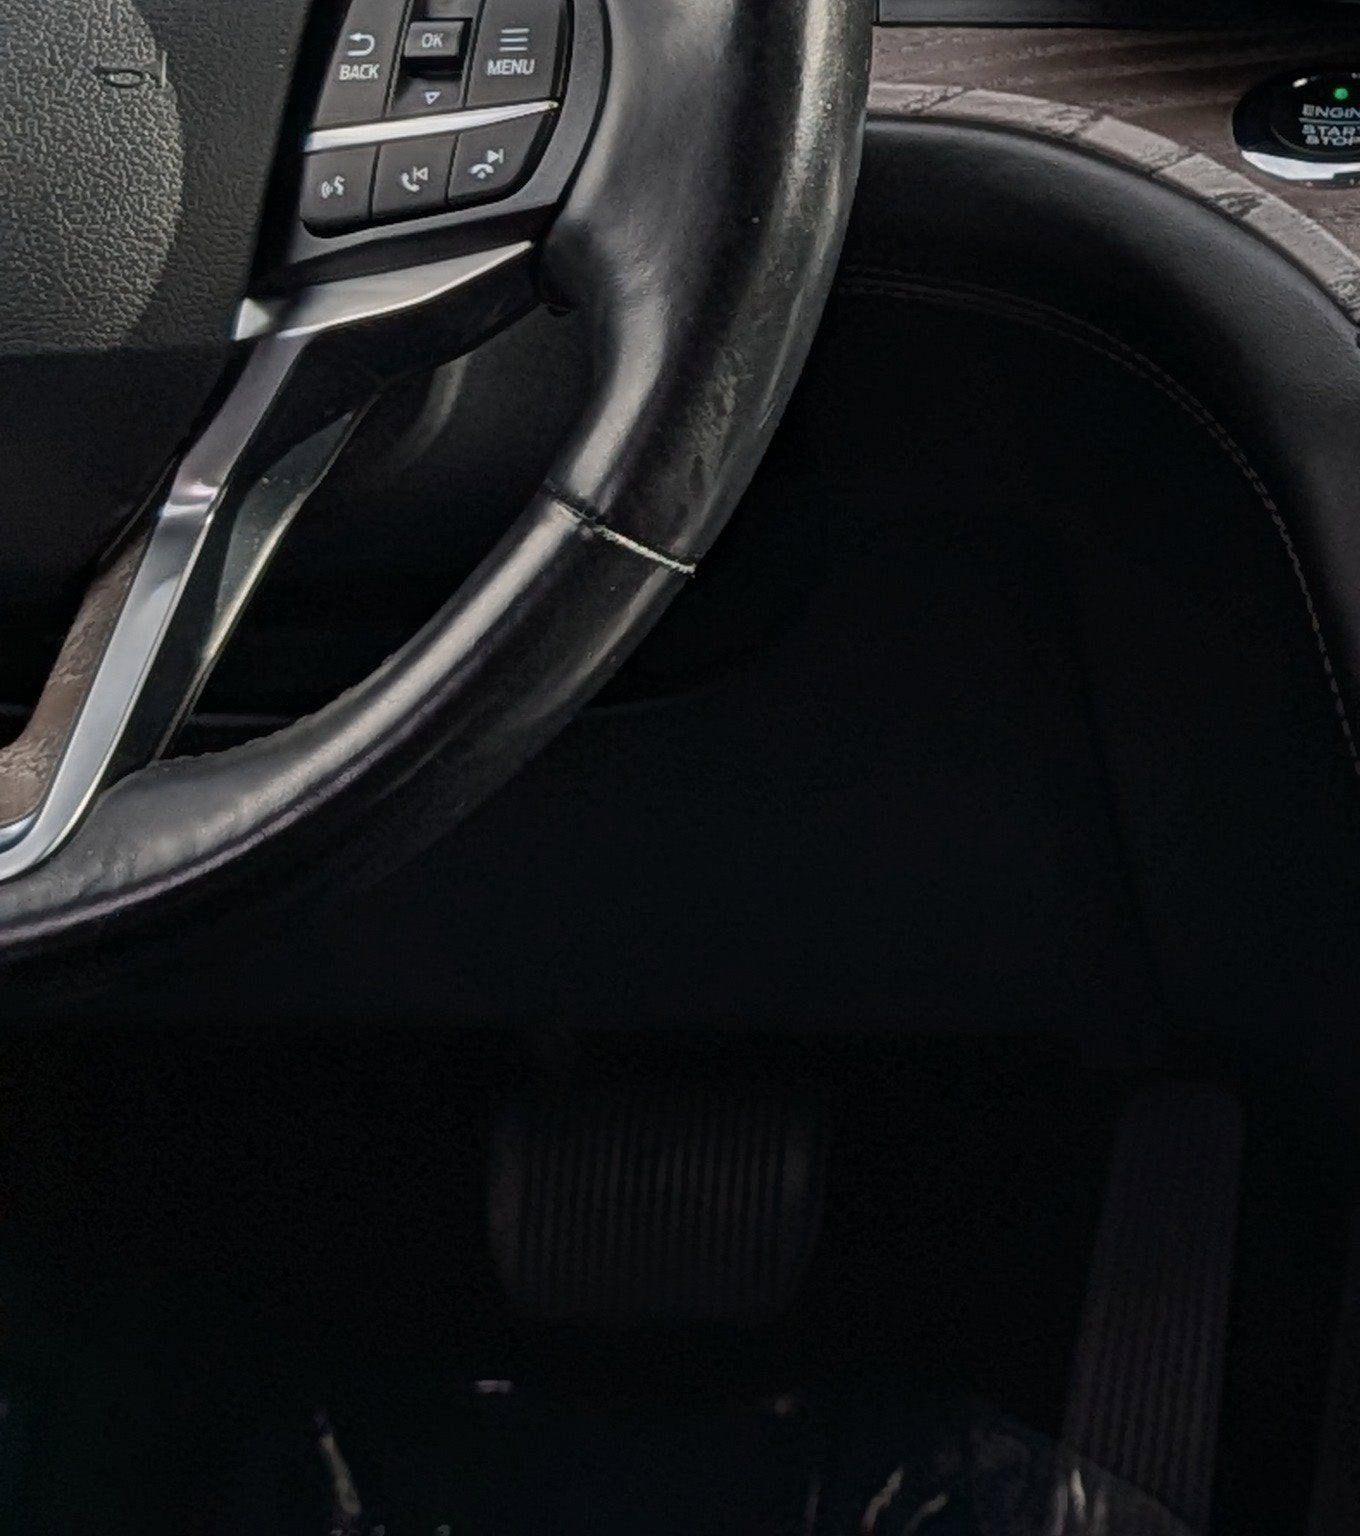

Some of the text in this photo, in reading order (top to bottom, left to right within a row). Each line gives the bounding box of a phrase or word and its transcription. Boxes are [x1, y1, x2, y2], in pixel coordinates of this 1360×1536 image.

[421, 33, 444, 48] OK
[339, 63, 380, 81] BACK
[487, 59, 535, 76] MENU
